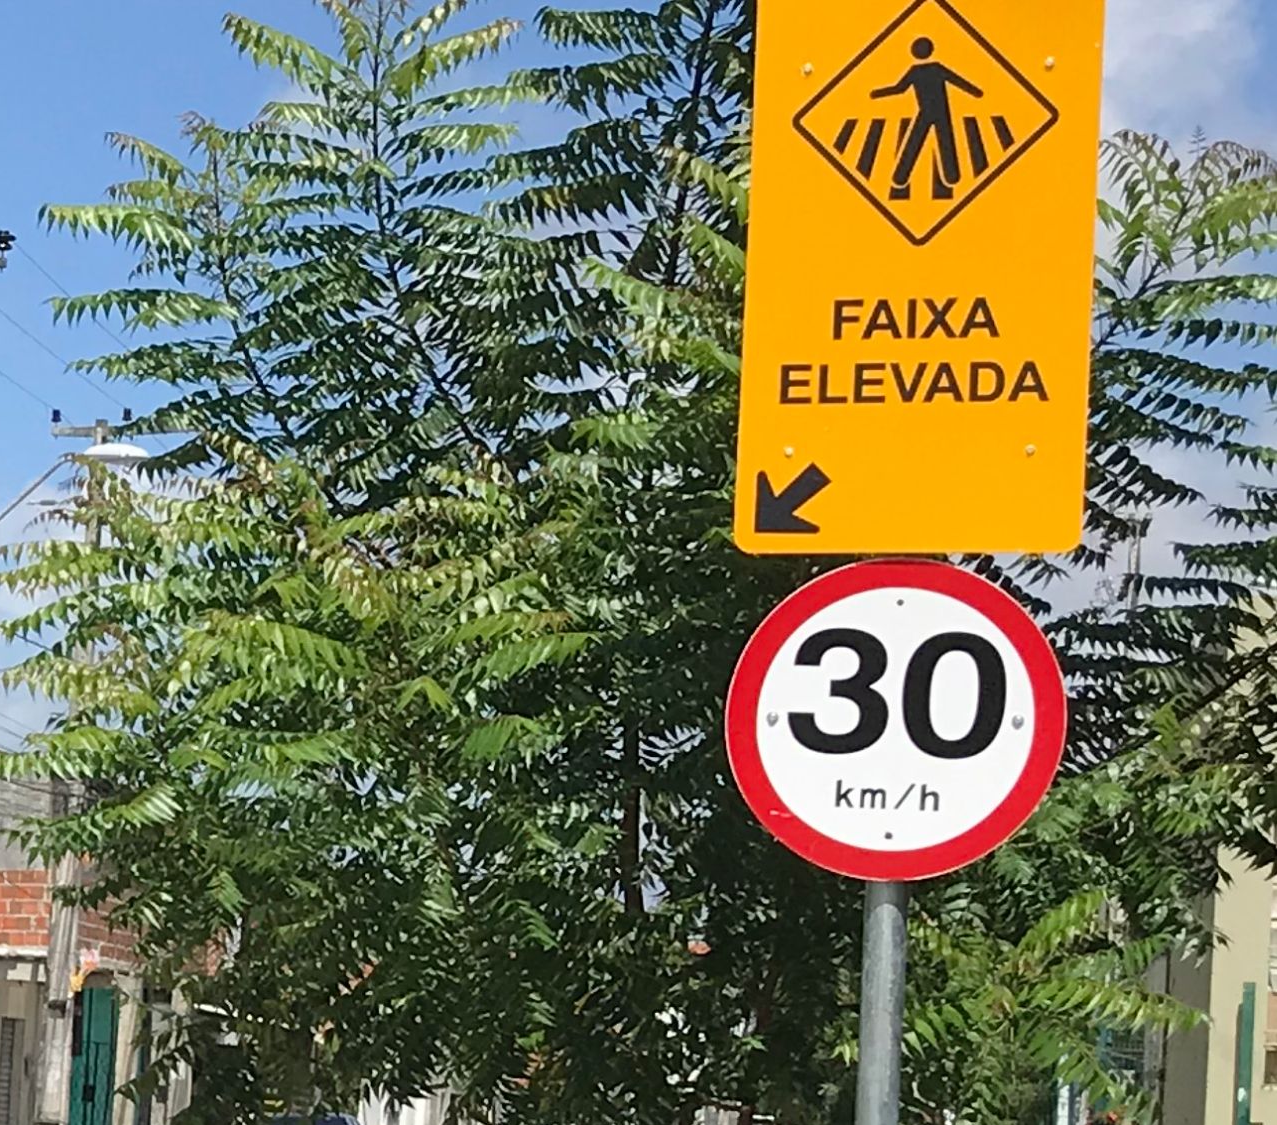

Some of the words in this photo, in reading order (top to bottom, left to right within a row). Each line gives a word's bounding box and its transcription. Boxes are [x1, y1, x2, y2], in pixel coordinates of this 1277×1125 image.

[832, 297, 1000, 340] FAIXA
[779, 361, 1050, 404] ELEVADA
[787, 627, 1007, 760] 30
[834, 779, 940, 812] km/h
